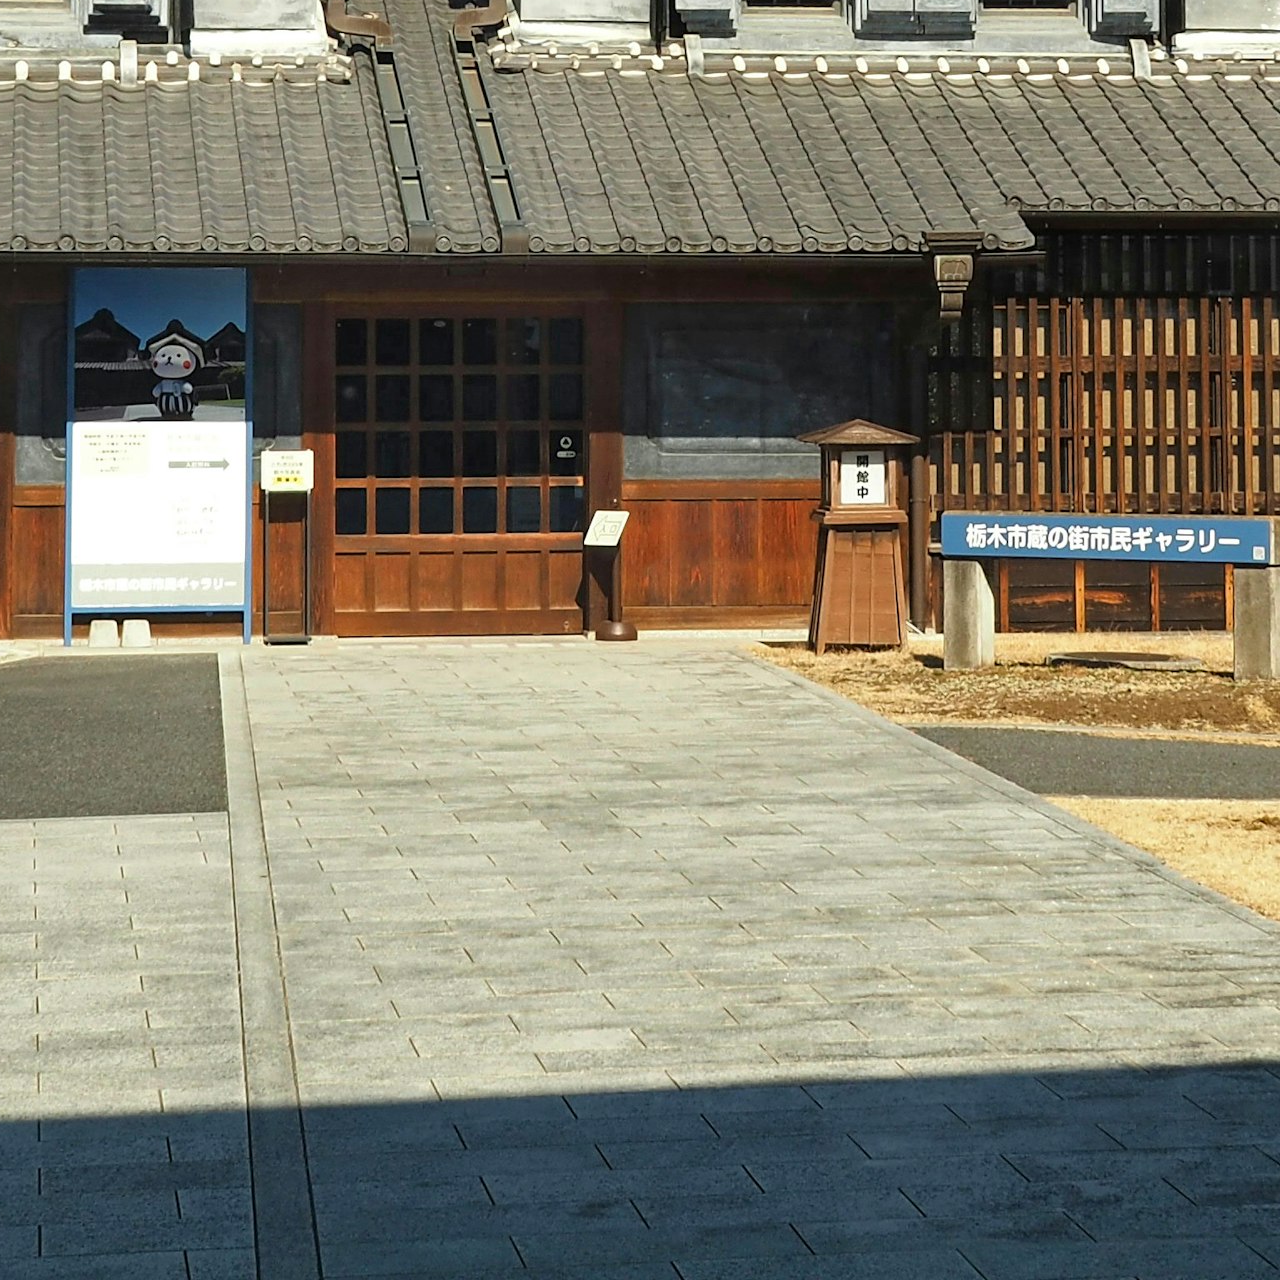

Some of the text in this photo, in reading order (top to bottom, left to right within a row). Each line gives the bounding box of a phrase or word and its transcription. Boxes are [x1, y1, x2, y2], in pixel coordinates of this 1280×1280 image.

[856, 455, 869, 499] 開館中
[965, 523, 1241, 553] 栃木市蔵の街市民ギャラリー
